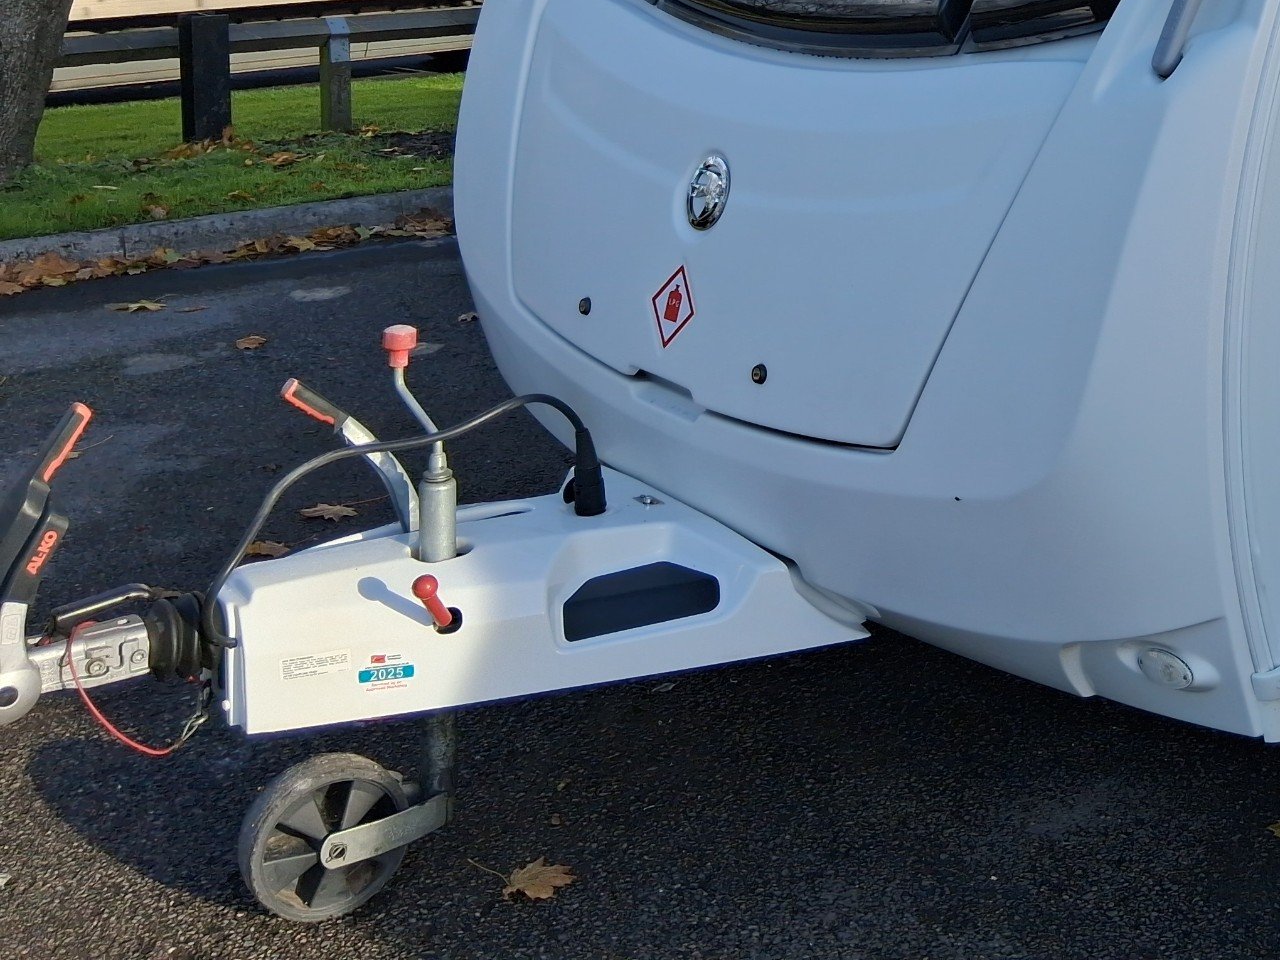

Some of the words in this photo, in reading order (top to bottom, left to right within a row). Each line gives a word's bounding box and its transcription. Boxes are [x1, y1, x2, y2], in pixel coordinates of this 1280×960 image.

[668, 298, 680, 308] LPG
[26, 530, 58, 575] AL-KO
[370, 667, 405, 681] 2025
